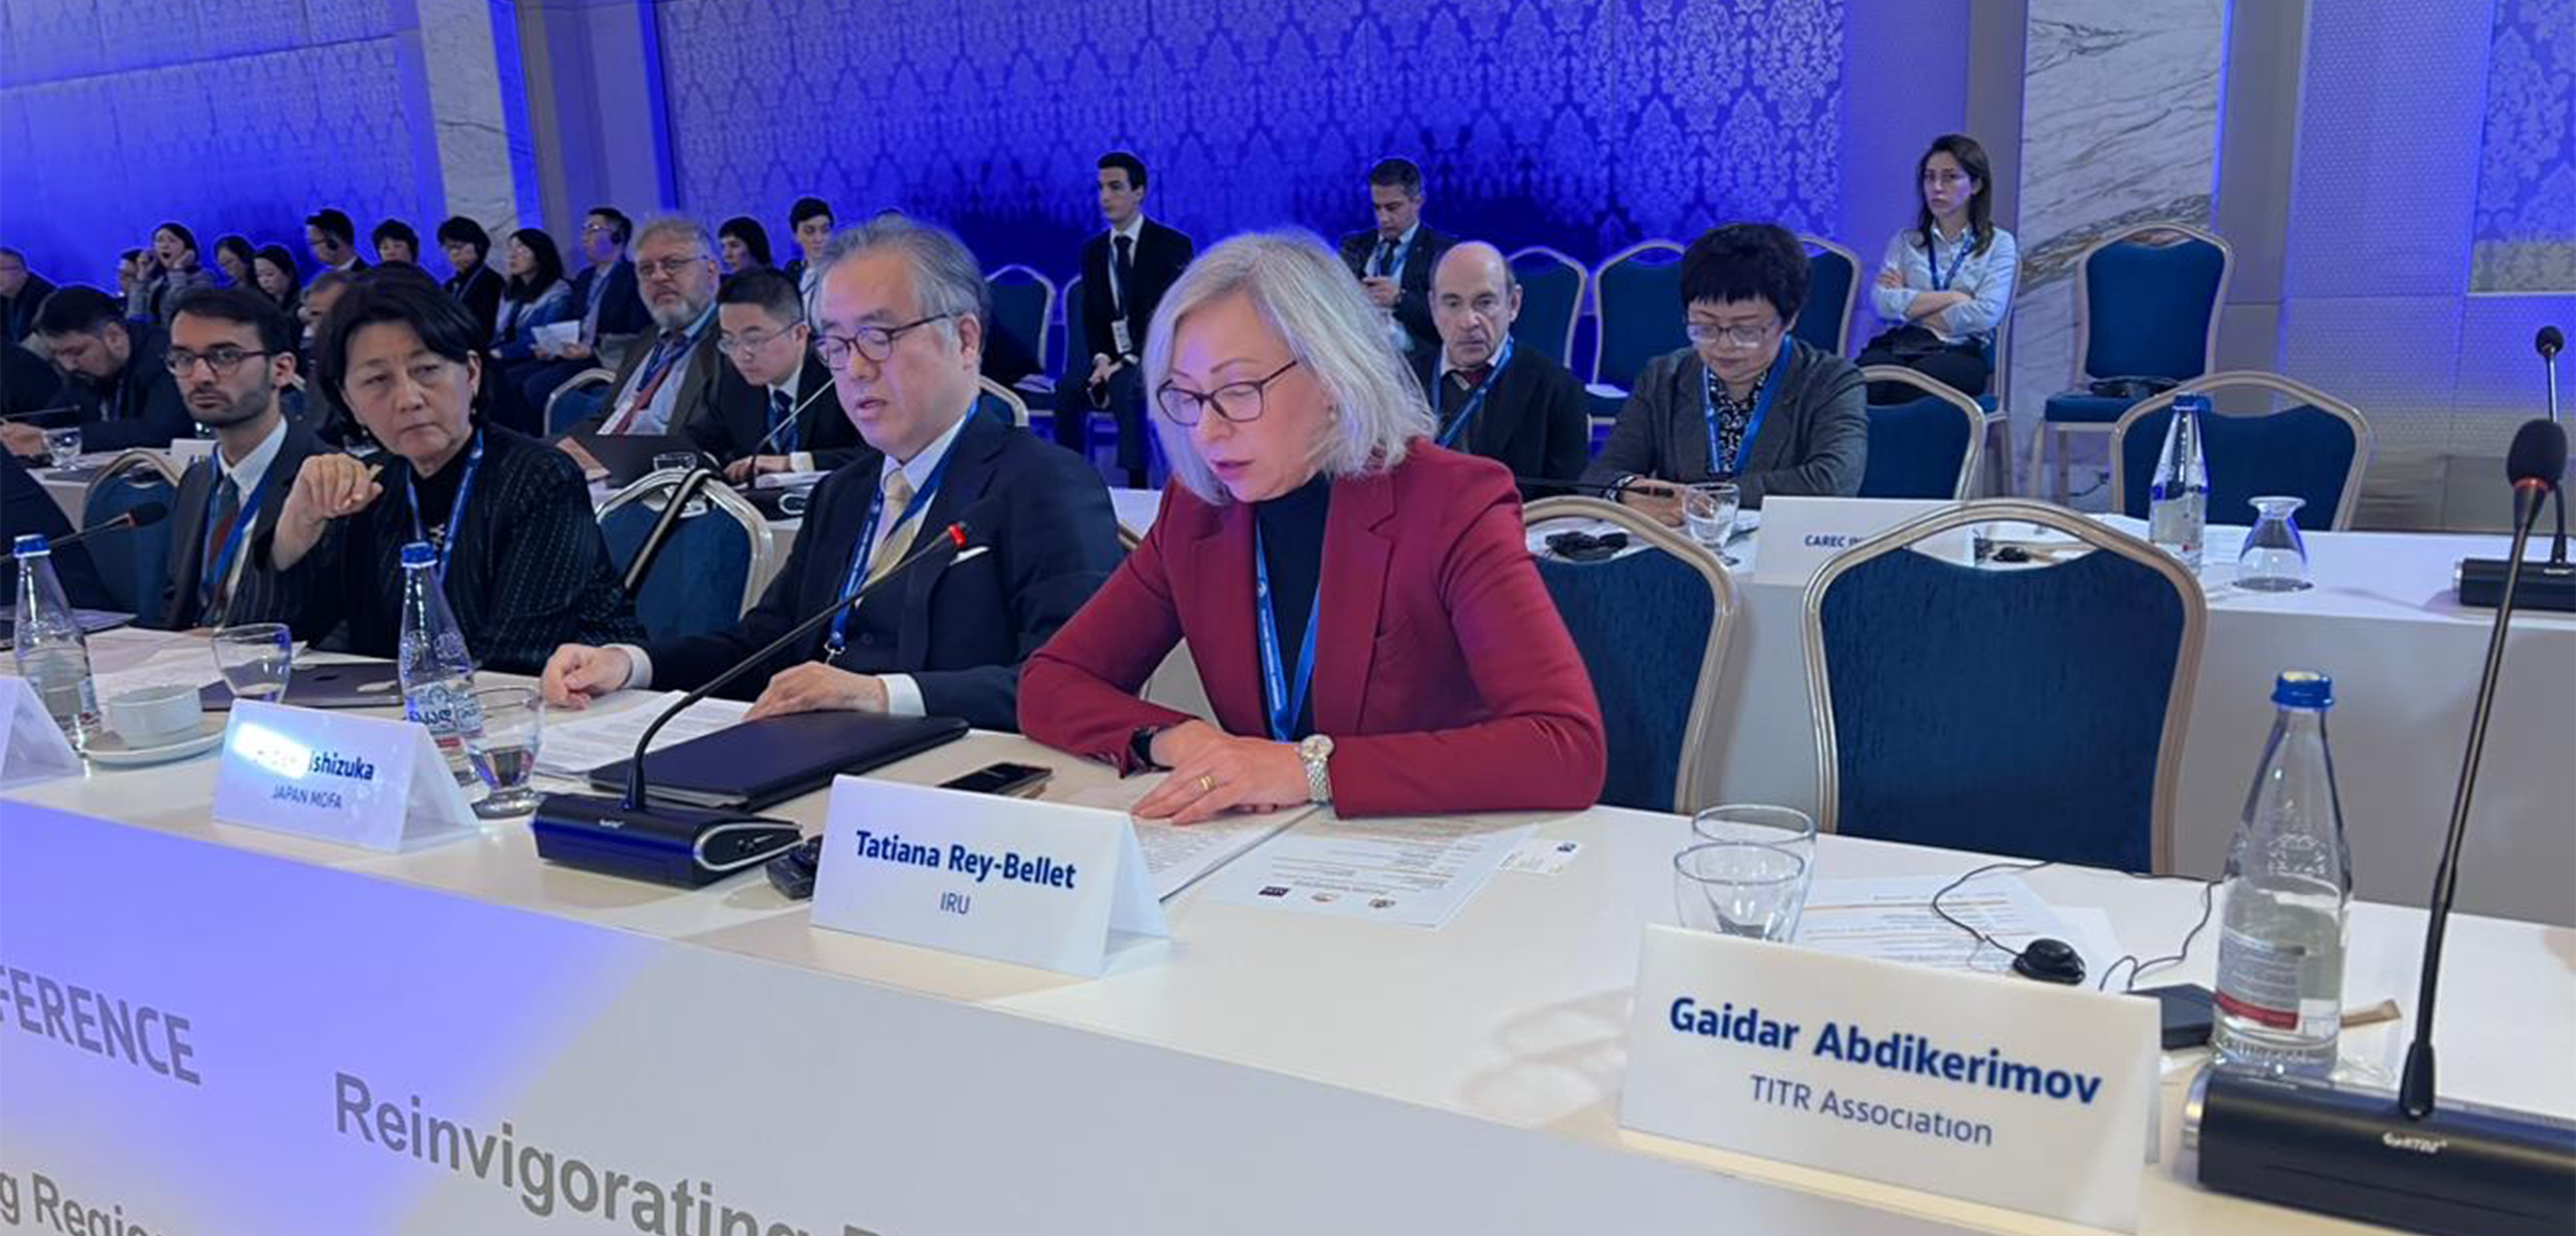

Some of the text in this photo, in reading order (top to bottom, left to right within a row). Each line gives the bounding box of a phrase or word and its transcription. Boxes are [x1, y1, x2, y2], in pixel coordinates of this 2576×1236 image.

[1804, 534, 1846, 547] CAREC
[272, 784, 308, 804] JAPAN
[856, 830, 1077, 888] Tatiana Rey-Bellet
[940, 892, 971, 914] IRU
[1670, 997, 2101, 1104] Gaidar Abdikerimov
[1751, 1075, 1993, 1146] TITR Association
[334, 1071, 810, 1236] Reinvigoratin
